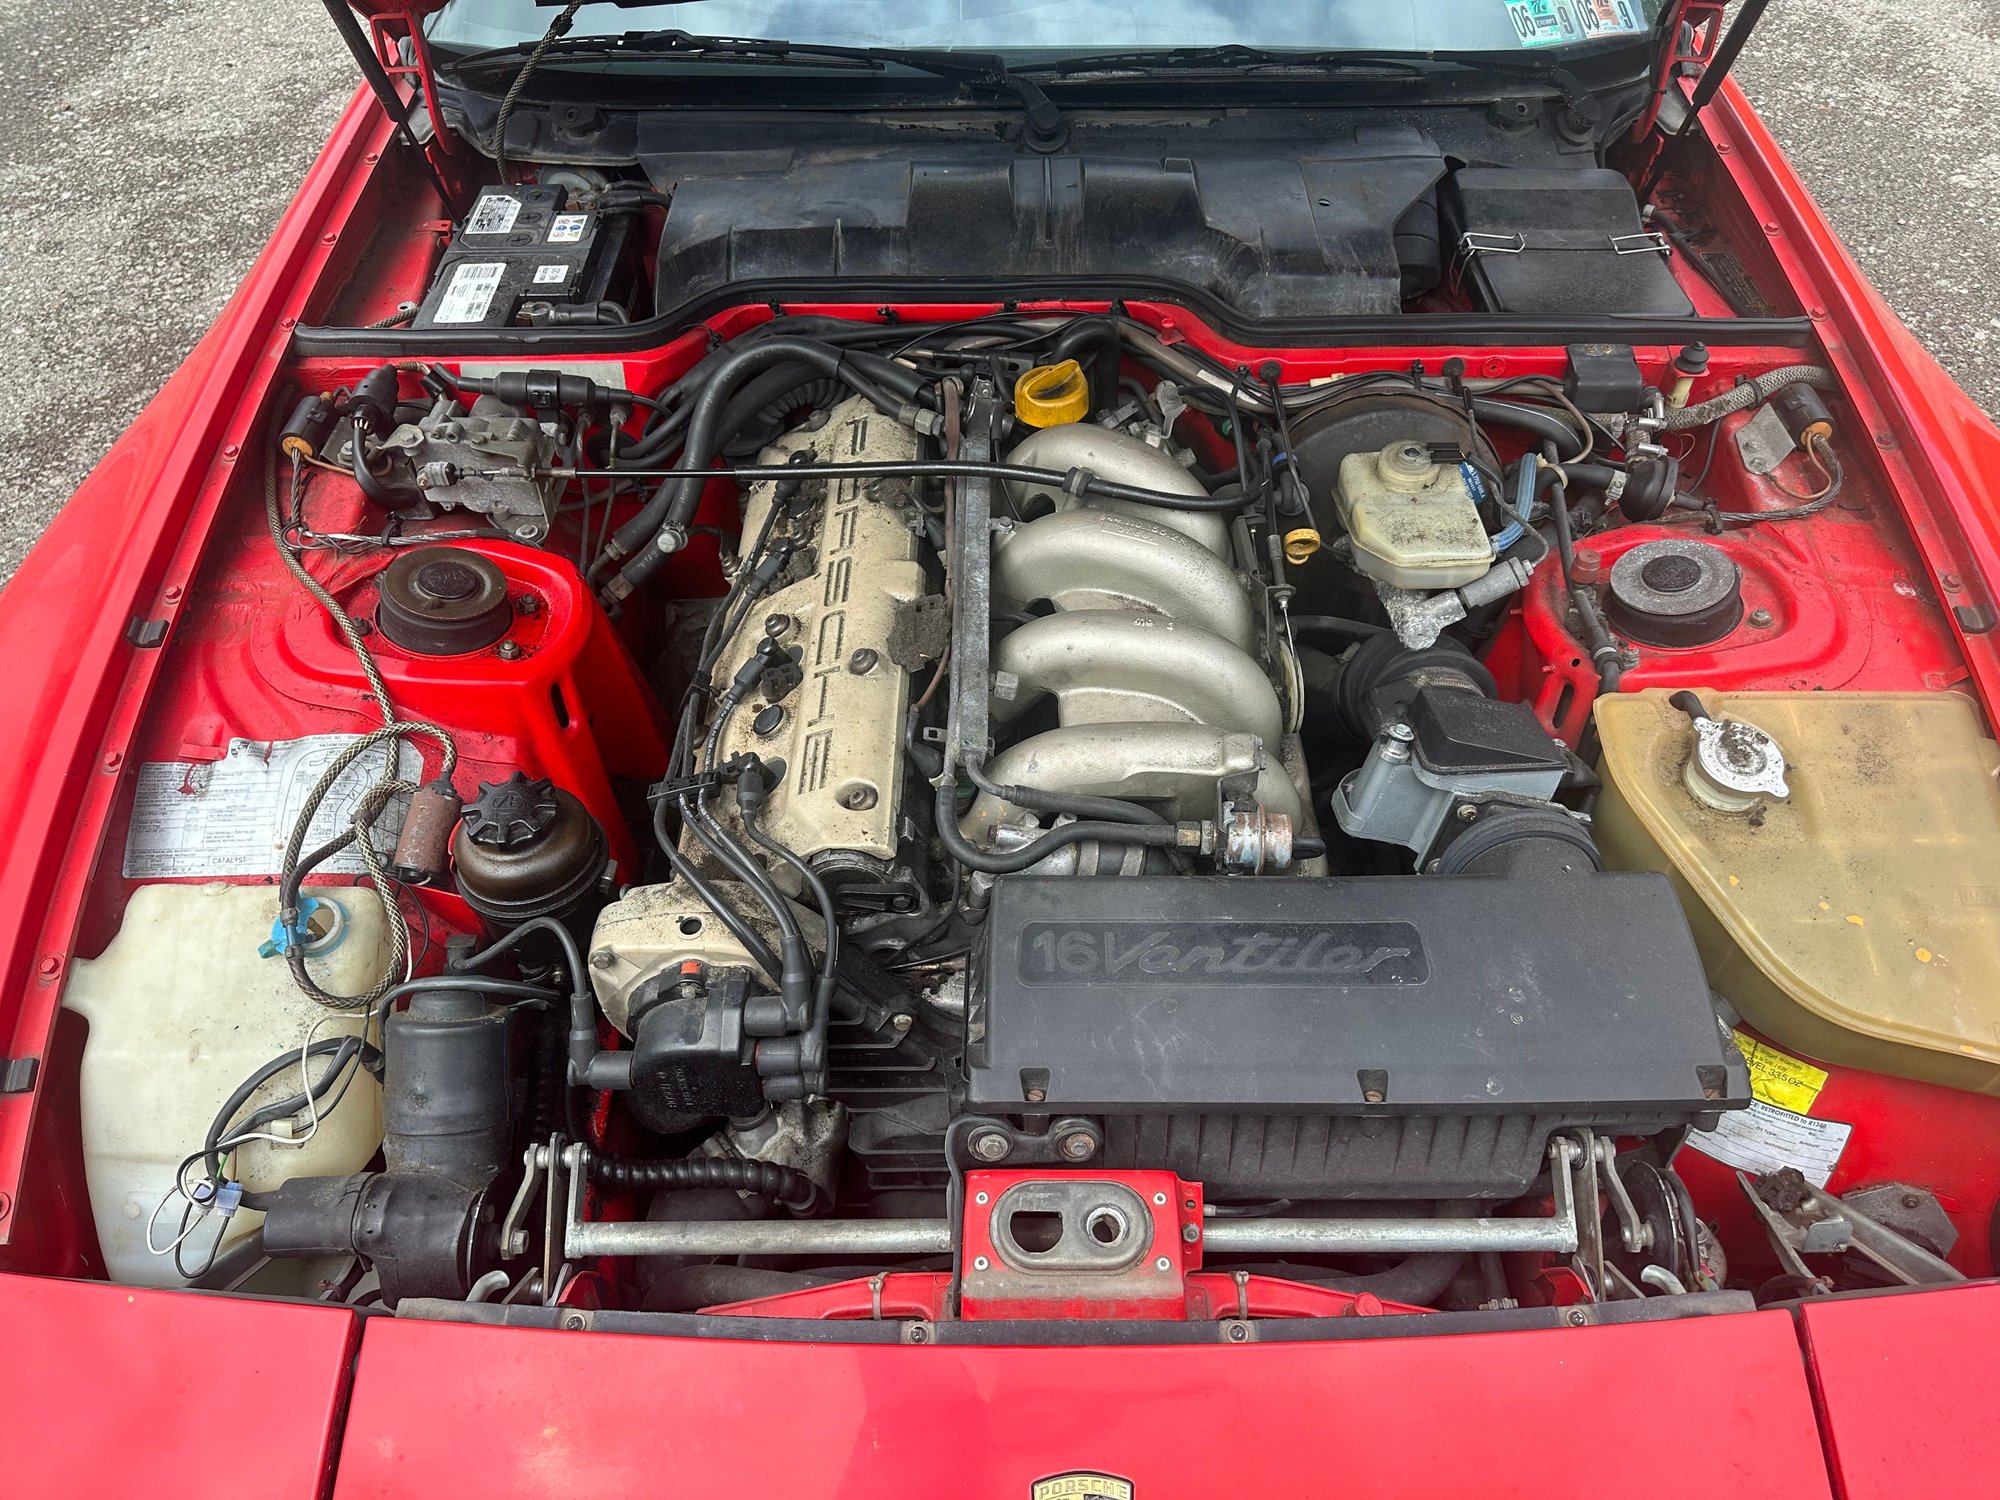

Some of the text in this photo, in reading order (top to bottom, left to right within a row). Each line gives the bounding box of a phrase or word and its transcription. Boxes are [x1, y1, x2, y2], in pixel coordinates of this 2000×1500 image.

[1511, 5, 1536, 38] 06
[212, 856, 247, 864] CATALYST
[1746, 1056, 1766, 1073] EVEL
[1760, 1105, 1800, 1122] RETROFITTED
[1687, 1138, 1698, 1146] City
[1764, 1129, 1777, 1137] Type
[1799, 1140, 1820, 1148] Amount
[1039, 1479, 1128, 1499] PORSCHE
